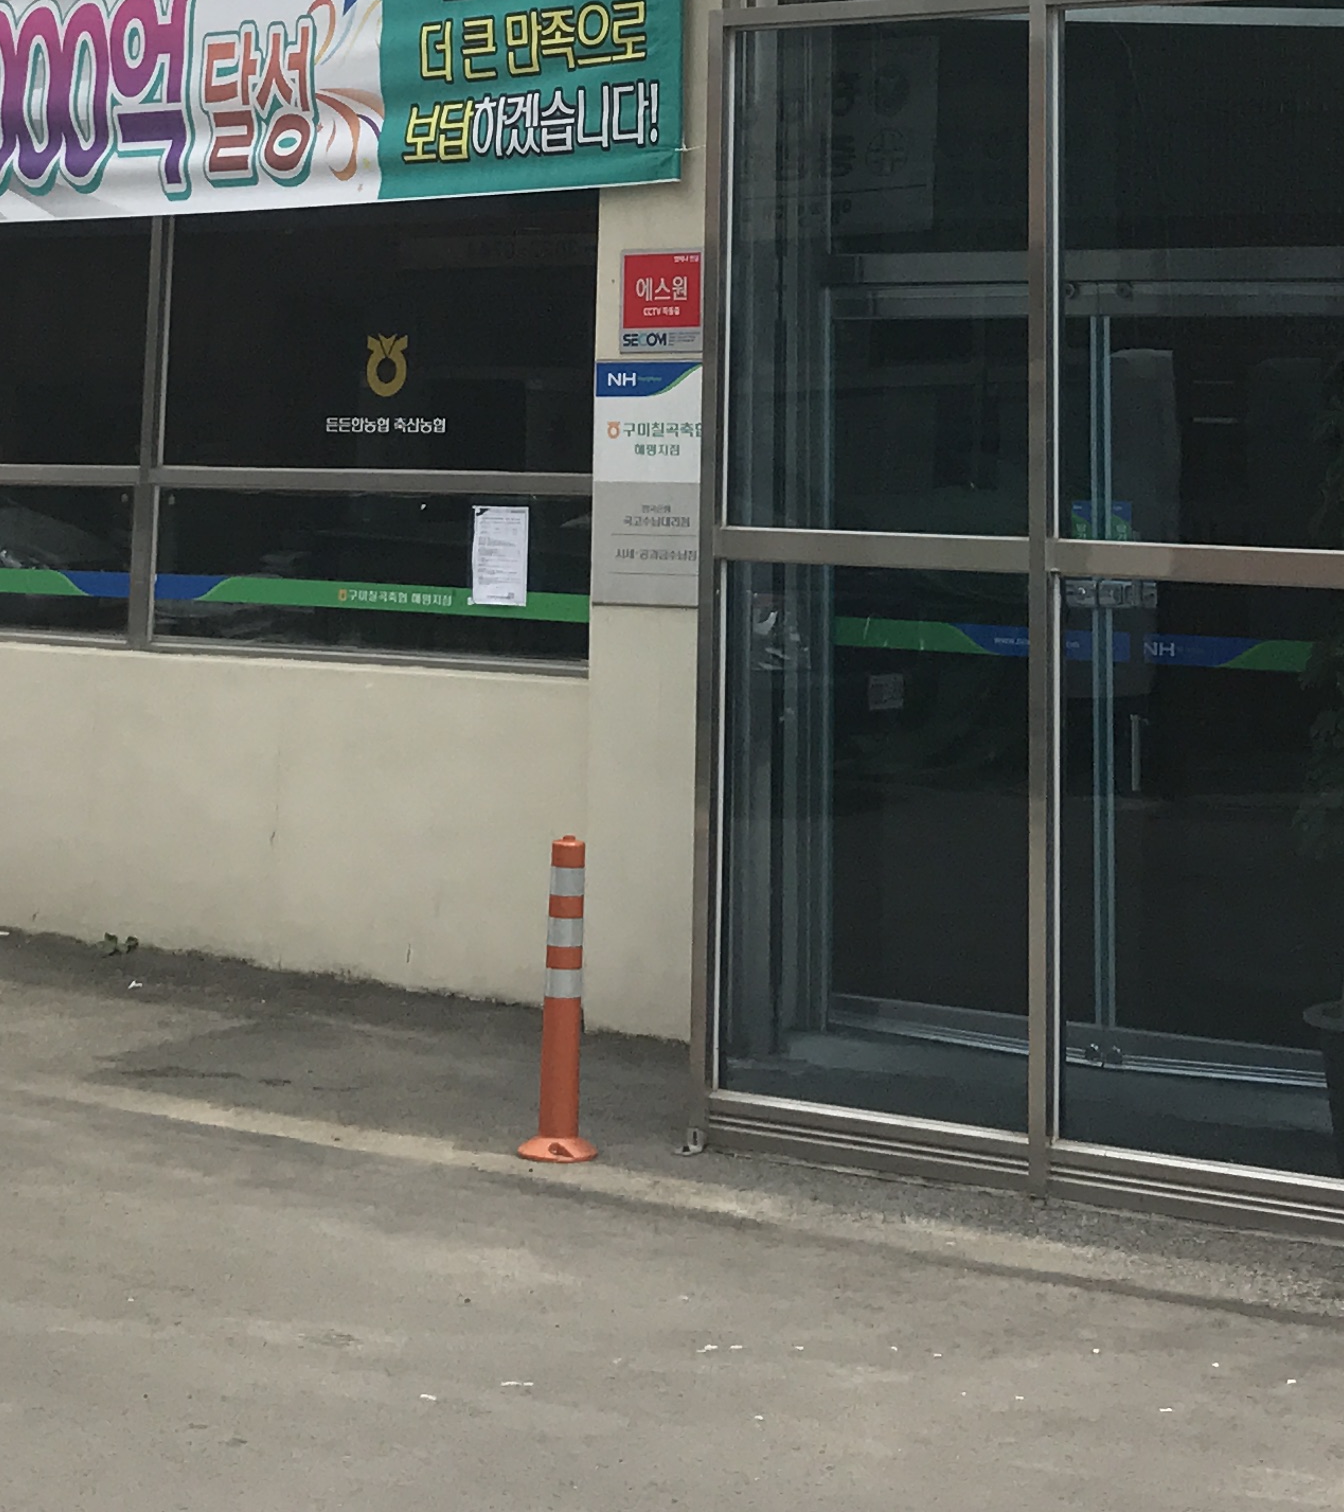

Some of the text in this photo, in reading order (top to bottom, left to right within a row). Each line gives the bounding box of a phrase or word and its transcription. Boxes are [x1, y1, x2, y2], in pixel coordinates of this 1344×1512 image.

[420, 0, 648, 82] 더 큰 만족으로
[204, 23, 315, 176] 달성
[402, 81, 660, 162] 보답하겠습니다!
[636, 276, 688, 302] 에스원
[642, 307, 662, 317] CCTV
[622, 332, 667, 347] SECOM
[607, 371, 637, 387] NH
[325, 417, 446, 433] 든든한농협 축산농협
[634, 443, 681, 457] 해평지점
[1142, 641, 1176, 658] NH
